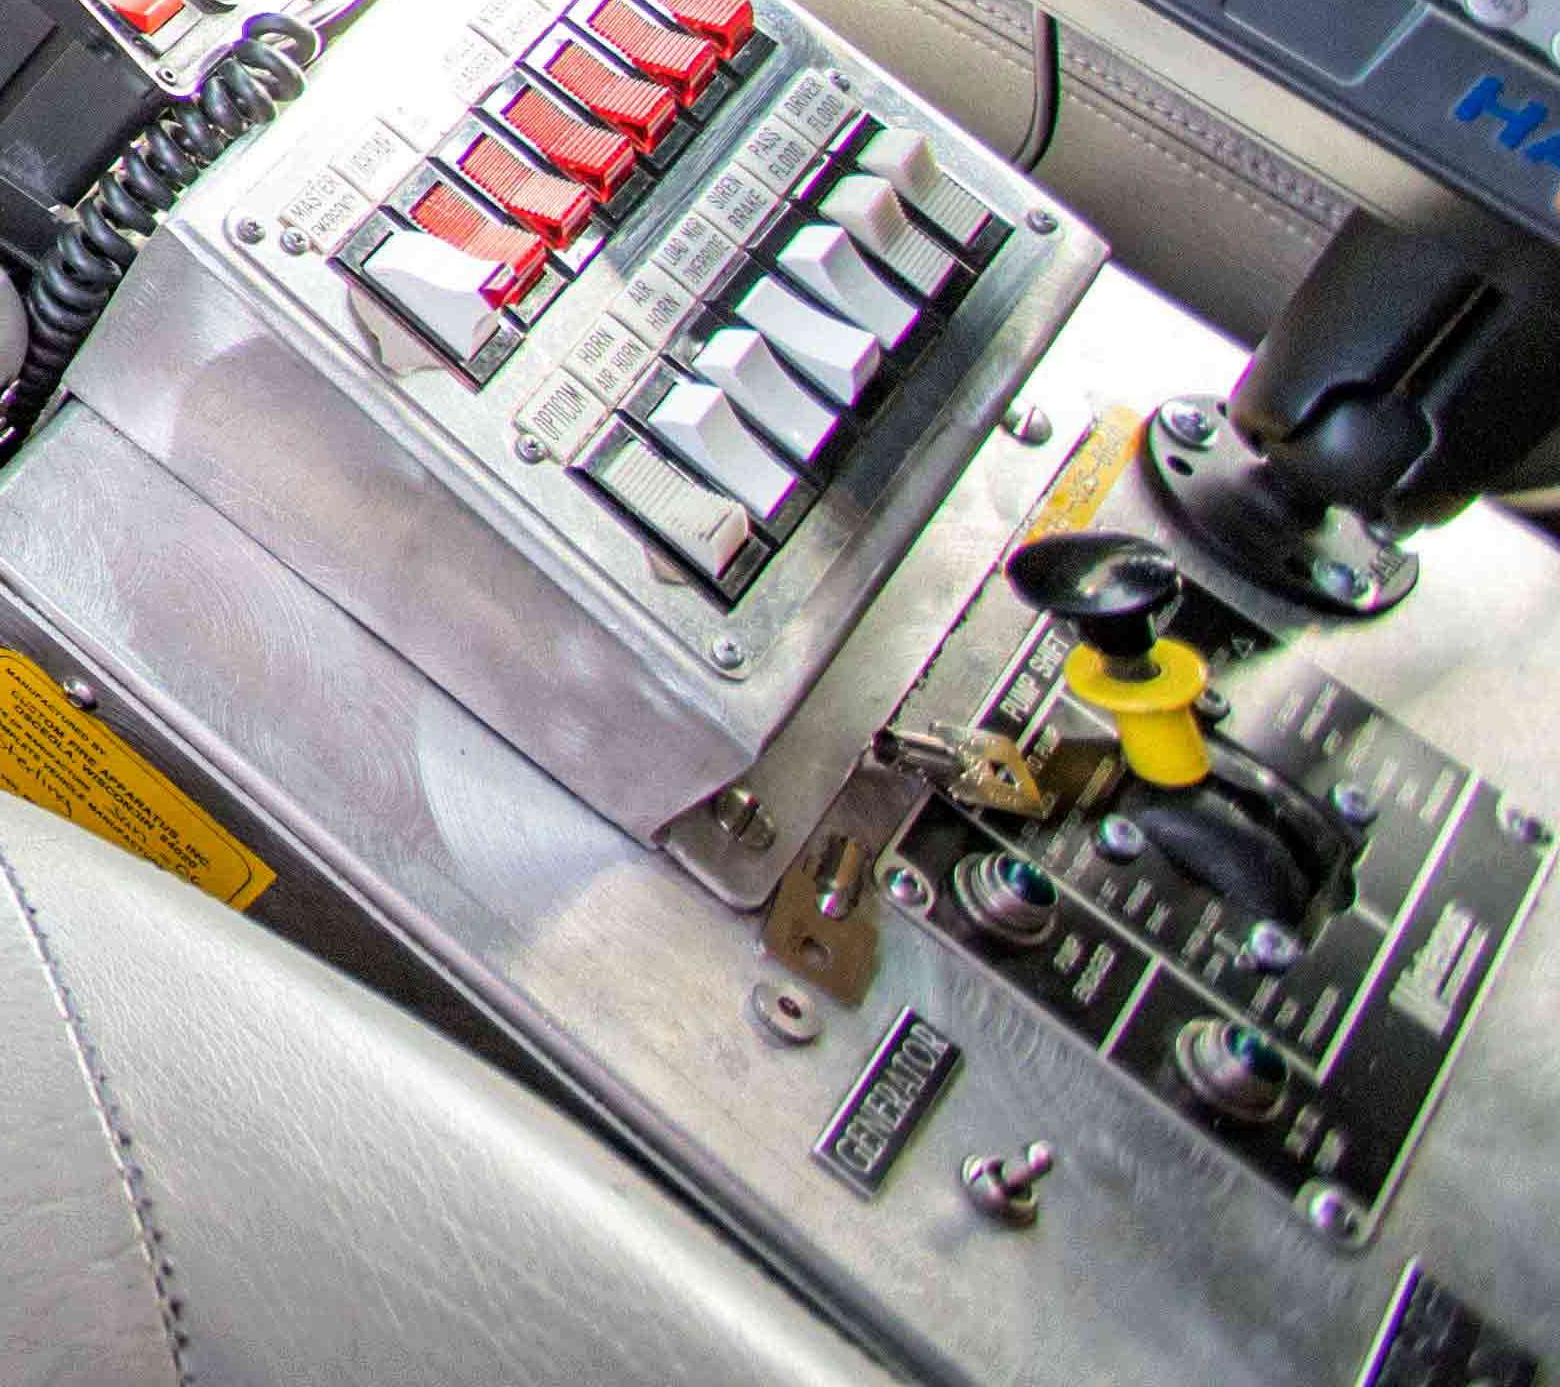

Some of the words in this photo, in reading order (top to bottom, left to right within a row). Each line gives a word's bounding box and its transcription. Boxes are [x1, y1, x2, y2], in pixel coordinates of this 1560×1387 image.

[746, 125, 782, 158] PASS
[289, 175, 346, 220] MASTER
[727, 186, 767, 230] BRAKE
[625, 278, 656, 308] AIR
[645, 291, 682, 334] HORN
[575, 325, 617, 365] HORN
[593, 369, 620, 392] AIR
[612, 337, 645, 375] HORN
[531, 379, 590, 442] OPTICOM
[3, 667, 93, 742] MANUFACTURED
[90, 741, 108, 757] BY
[999, 670, 1043, 723] PUMP
[9, 690, 67, 738] CUSTOM
[66, 739, 98, 767] FIRE
[835, 1023, 950, 1174] GENERATOR
